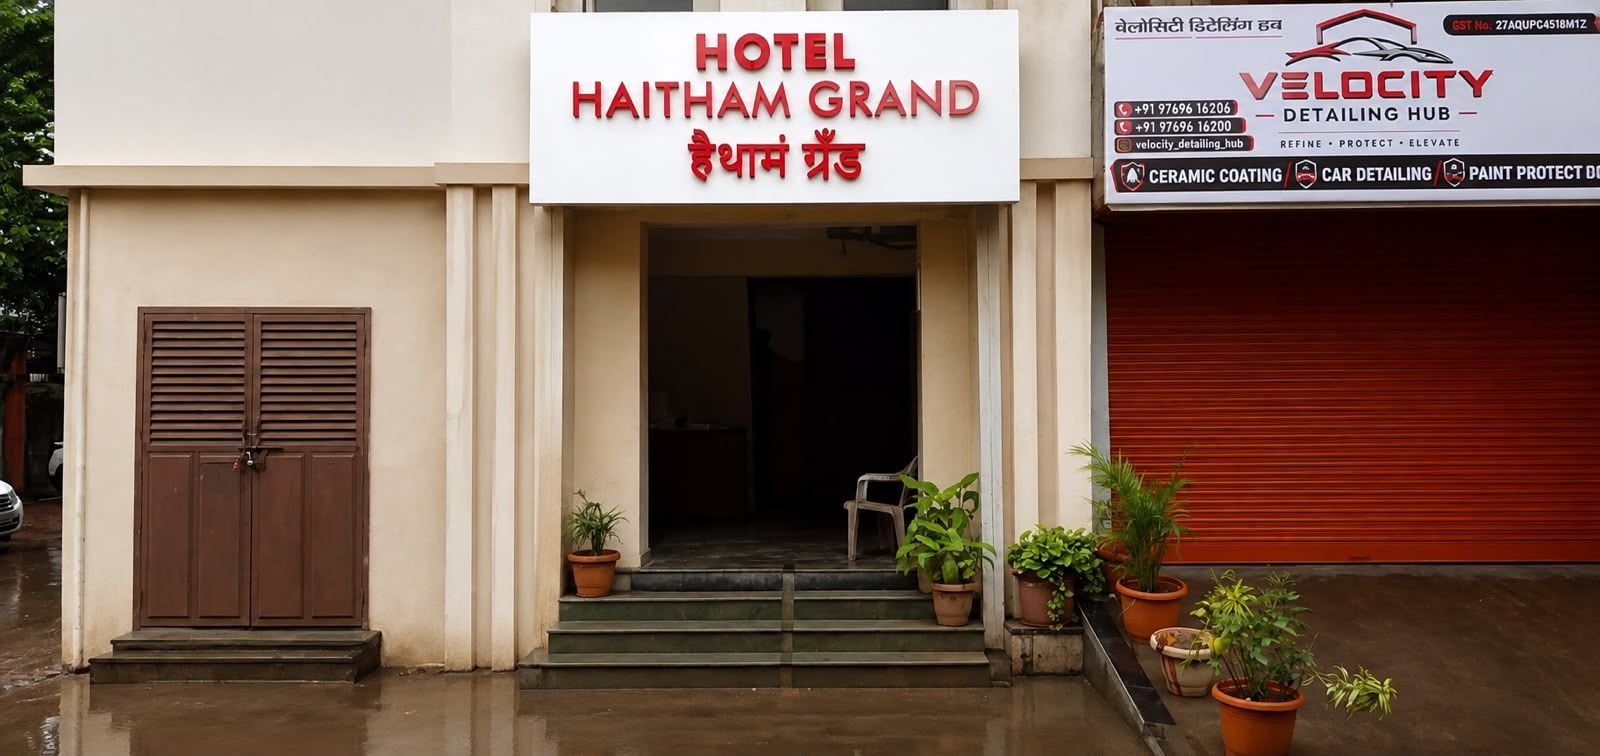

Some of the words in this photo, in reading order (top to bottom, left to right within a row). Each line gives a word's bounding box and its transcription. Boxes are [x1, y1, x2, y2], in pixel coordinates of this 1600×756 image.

[1452, 20, 1472, 31] GST
[1475, 20, 1493, 31] No:
[1496, 19, 1588, 31] 27AQUPC4518M1Z
[696, 33, 855, 71] HOTEL
[1239, 69, 1494, 101] VELOCITY
[572, 80, 792, 119] HAITHAM
[808, 79, 981, 118] GRAND
[1134, 104, 1155, 115] +91
[1158, 103, 1193, 115] 97696
[1197, 102, 1231, 114] 16206
[1283, 106, 1399, 123] DETAILING
[1408, 106, 1451, 121] HUB
[1135, 121, 1156, 133] +91
[1159, 121, 1194, 132] 97696
[1198, 120, 1232, 132] 16200
[1135, 139, 1244, 151] velocity_detailing_hub
[1280, 140, 1322, 149] REFINE
[1340, 139, 1393, 148] PROTECT
[1409, 138, 1460, 147] ELEVATE
[1149, 168, 1215, 184] CERAMIC
[1219, 168, 1283, 183] COATING
[1322, 167, 1352, 182] CAR
[1356, 166, 1432, 181] DETAILING
[1469, 165, 1512, 180] PAINT
[1516, 165, 1583, 180] PROTECT
